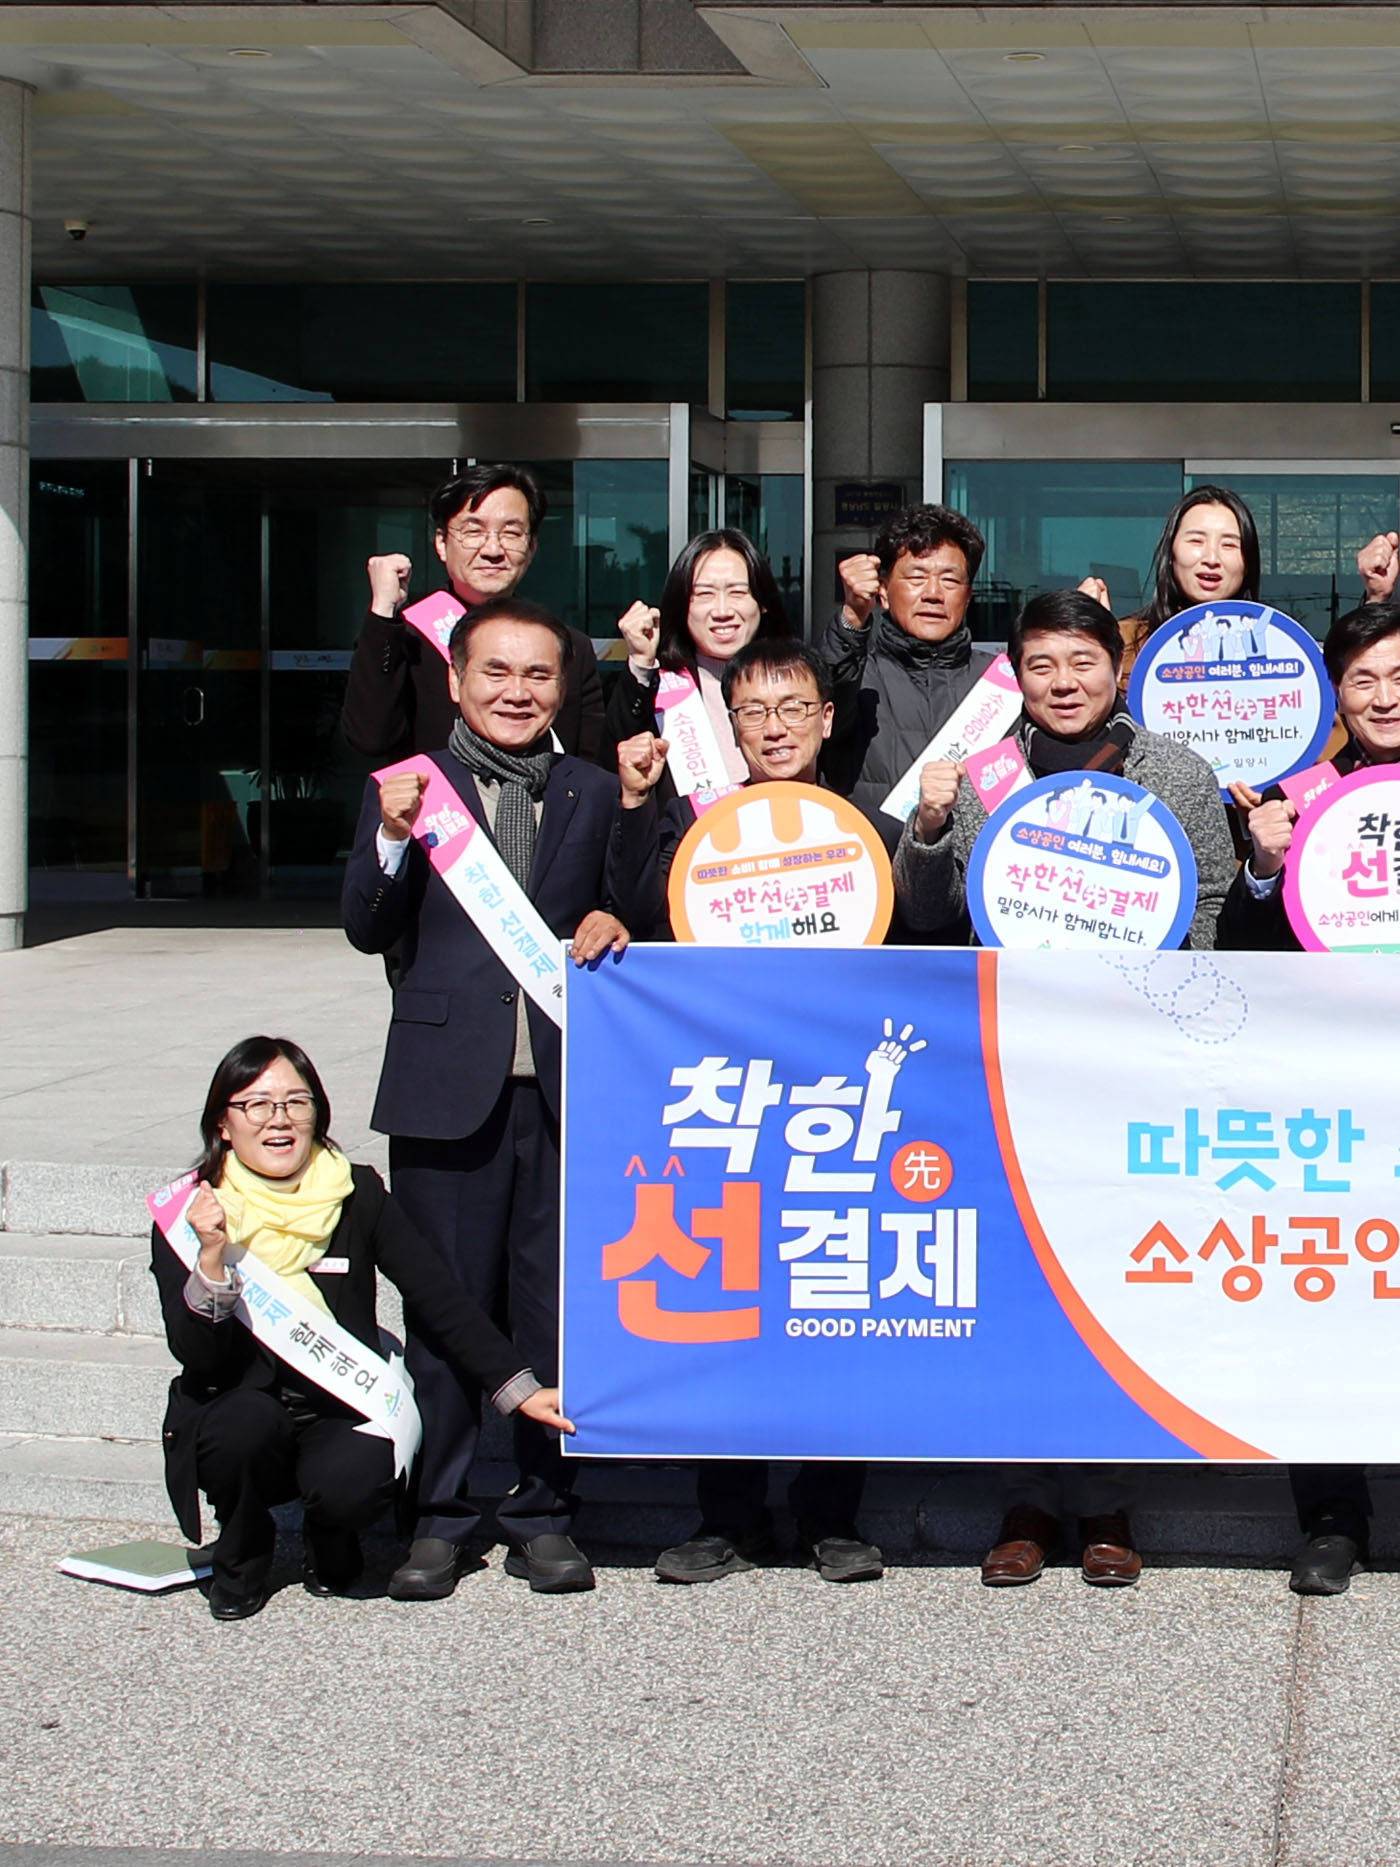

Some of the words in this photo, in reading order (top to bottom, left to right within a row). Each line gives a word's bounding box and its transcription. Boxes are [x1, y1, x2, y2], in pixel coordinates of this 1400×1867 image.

[1161, 666, 1206, 680] 소상공인
[1208, 662, 1246, 677] 여러분,
[1249, 661, 1299, 676] 힘내세요!
[961, 693, 1006, 745] 소상공인
[1225, 726, 1303, 743] 함께합니다.
[673, 711, 709, 777] 소상공인
[1233, 757, 1268, 768] 밀양시
[697, 866, 728, 880] 따뜻한
[783, 851, 823, 867] 성장하는
[826, 848, 846, 861] 우리
[1016, 825, 1065, 851] 소상공인
[1067, 840, 1107, 862] 여러분,
[1111, 849, 1165, 874] 힘내세요!
[464, 861, 505, 909] 착한
[500, 910, 559, 978] 선결제
[740, 912, 840, 943] 함께해요
[997, 897, 1059, 924] 밀양시가
[1064, 914, 1147, 946] 함께합니다.
[1318, 910, 1399, 928] 소상공인에게
[662, 1044, 903, 1193] 착한
[903, 1150, 942, 1190] 先
[1127, 1107, 1365, 1193] 따뜻한
[785, 1318, 856, 1338] GOOD
[861, 1318, 976, 1338] PAYMENT
